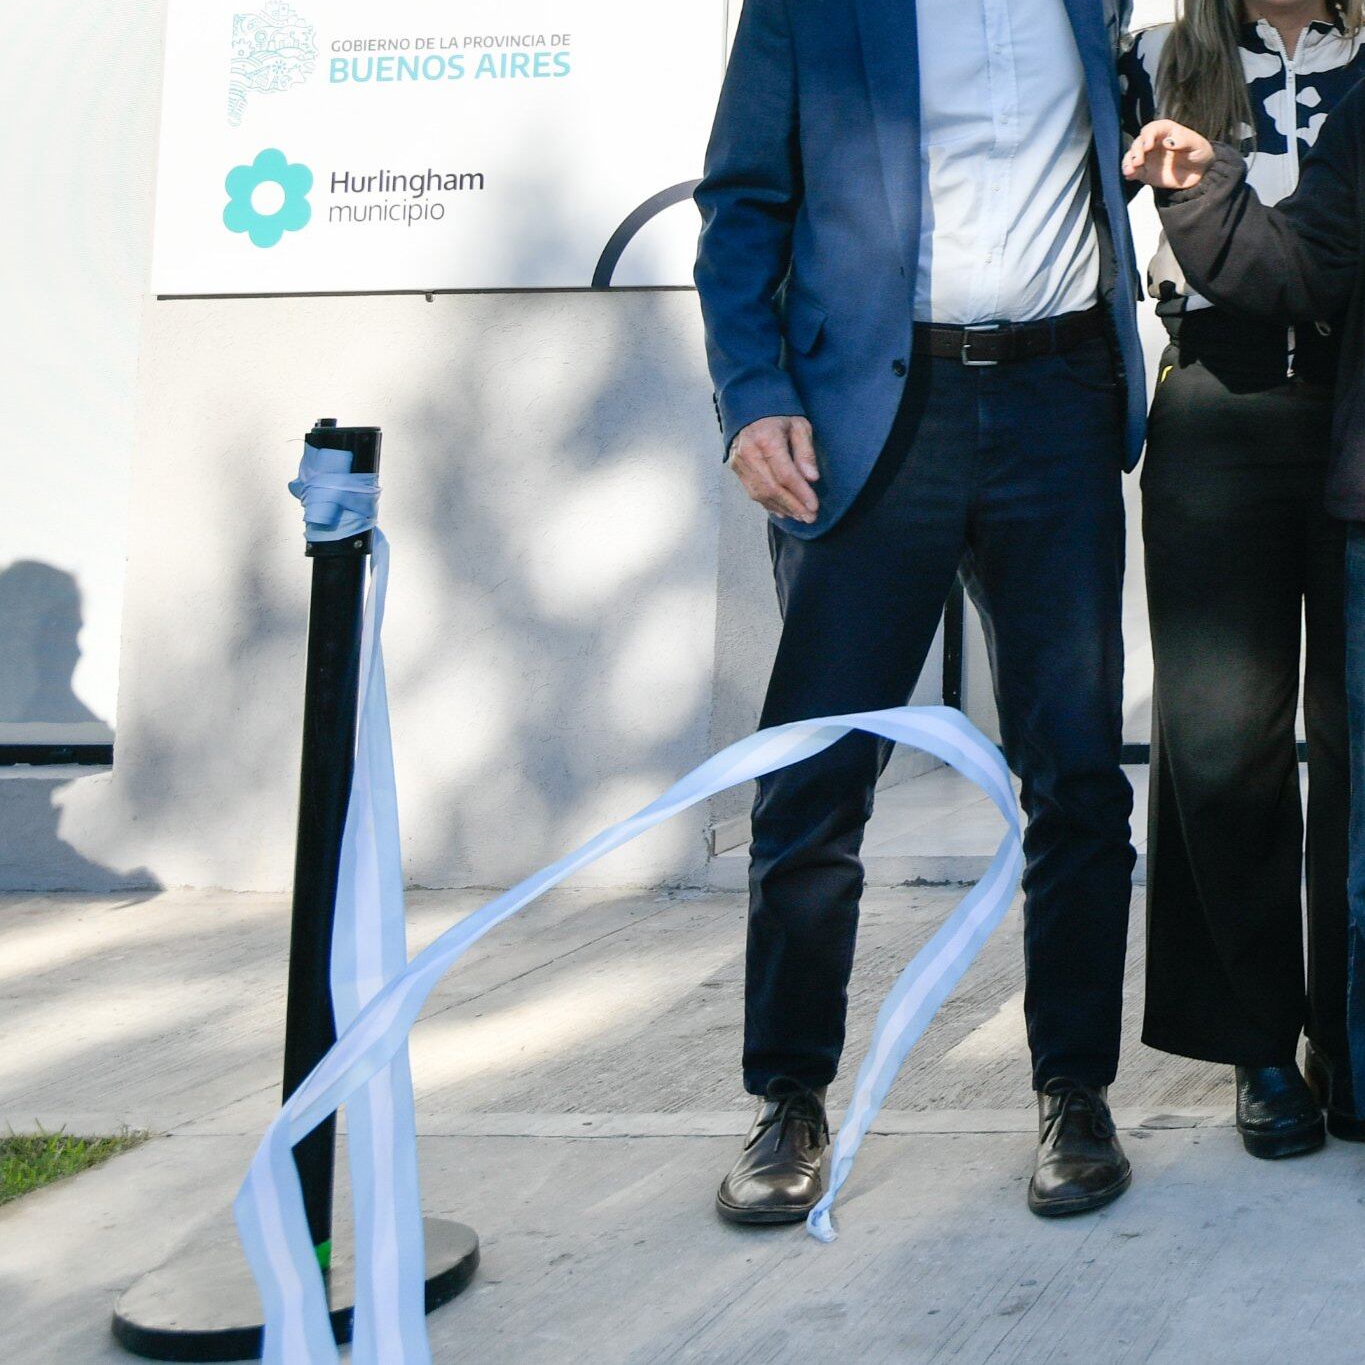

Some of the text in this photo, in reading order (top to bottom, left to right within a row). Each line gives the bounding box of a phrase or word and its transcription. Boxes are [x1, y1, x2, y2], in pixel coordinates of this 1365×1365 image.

[331, 34, 571, 52] GOBIERNO DE LA PROVINCIA DE
[329, 51, 572, 83] BUENOS AIRES
[330, 168, 485, 199] Hurlingham
[328, 198, 446, 227] municipio
